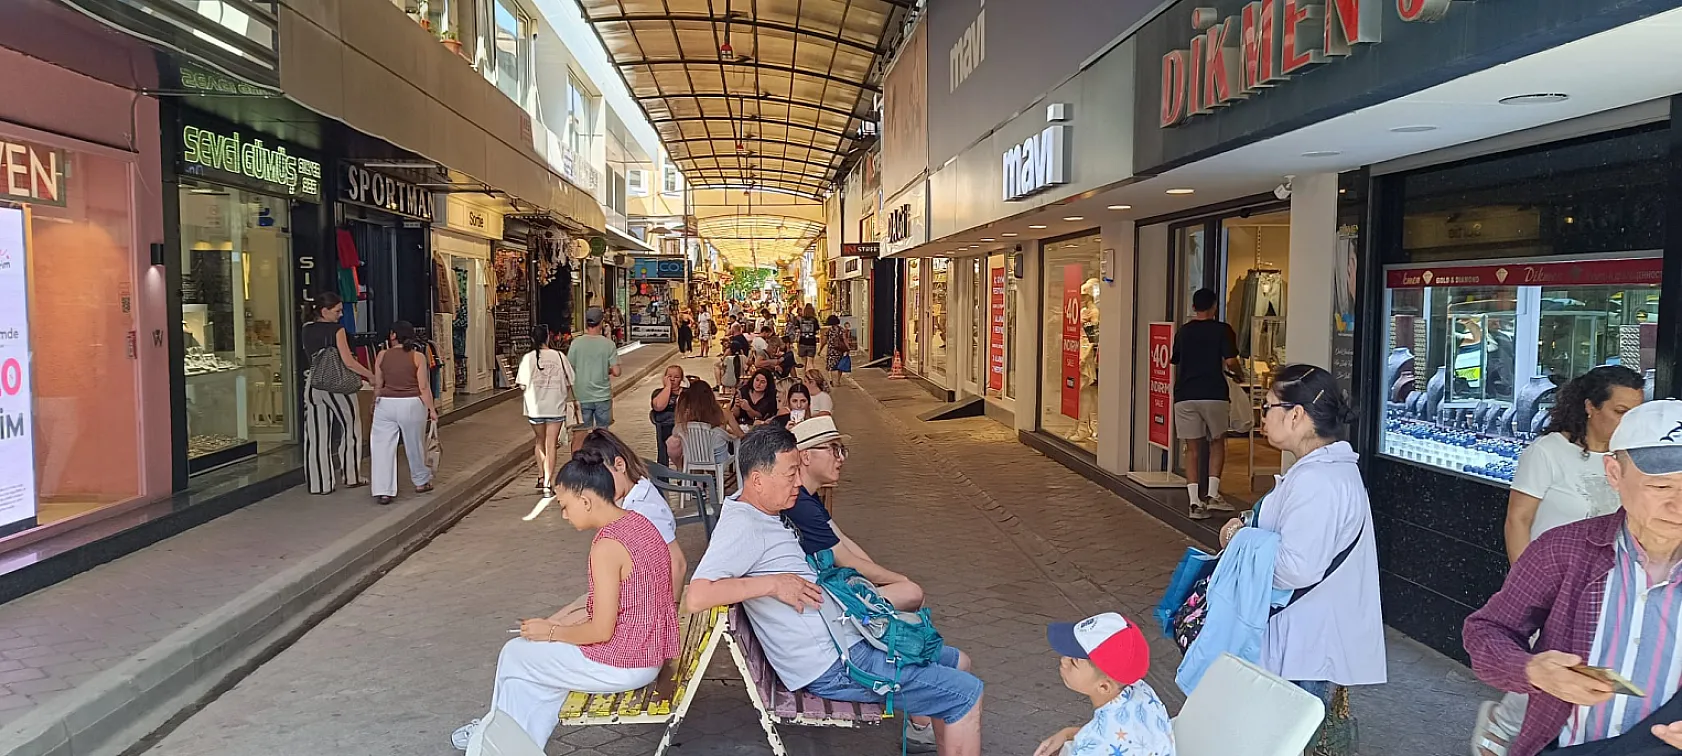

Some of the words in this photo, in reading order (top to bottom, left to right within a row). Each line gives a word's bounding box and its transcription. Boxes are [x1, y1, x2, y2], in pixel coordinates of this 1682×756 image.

[950, 0, 985, 94] mavi
[183, 125, 240, 174] SEVGİ
[241, 139, 298, 195] GÜMÜŞ
[348, 164, 434, 219] SPORTMAN
[1002, 103, 1067, 201] mavi
